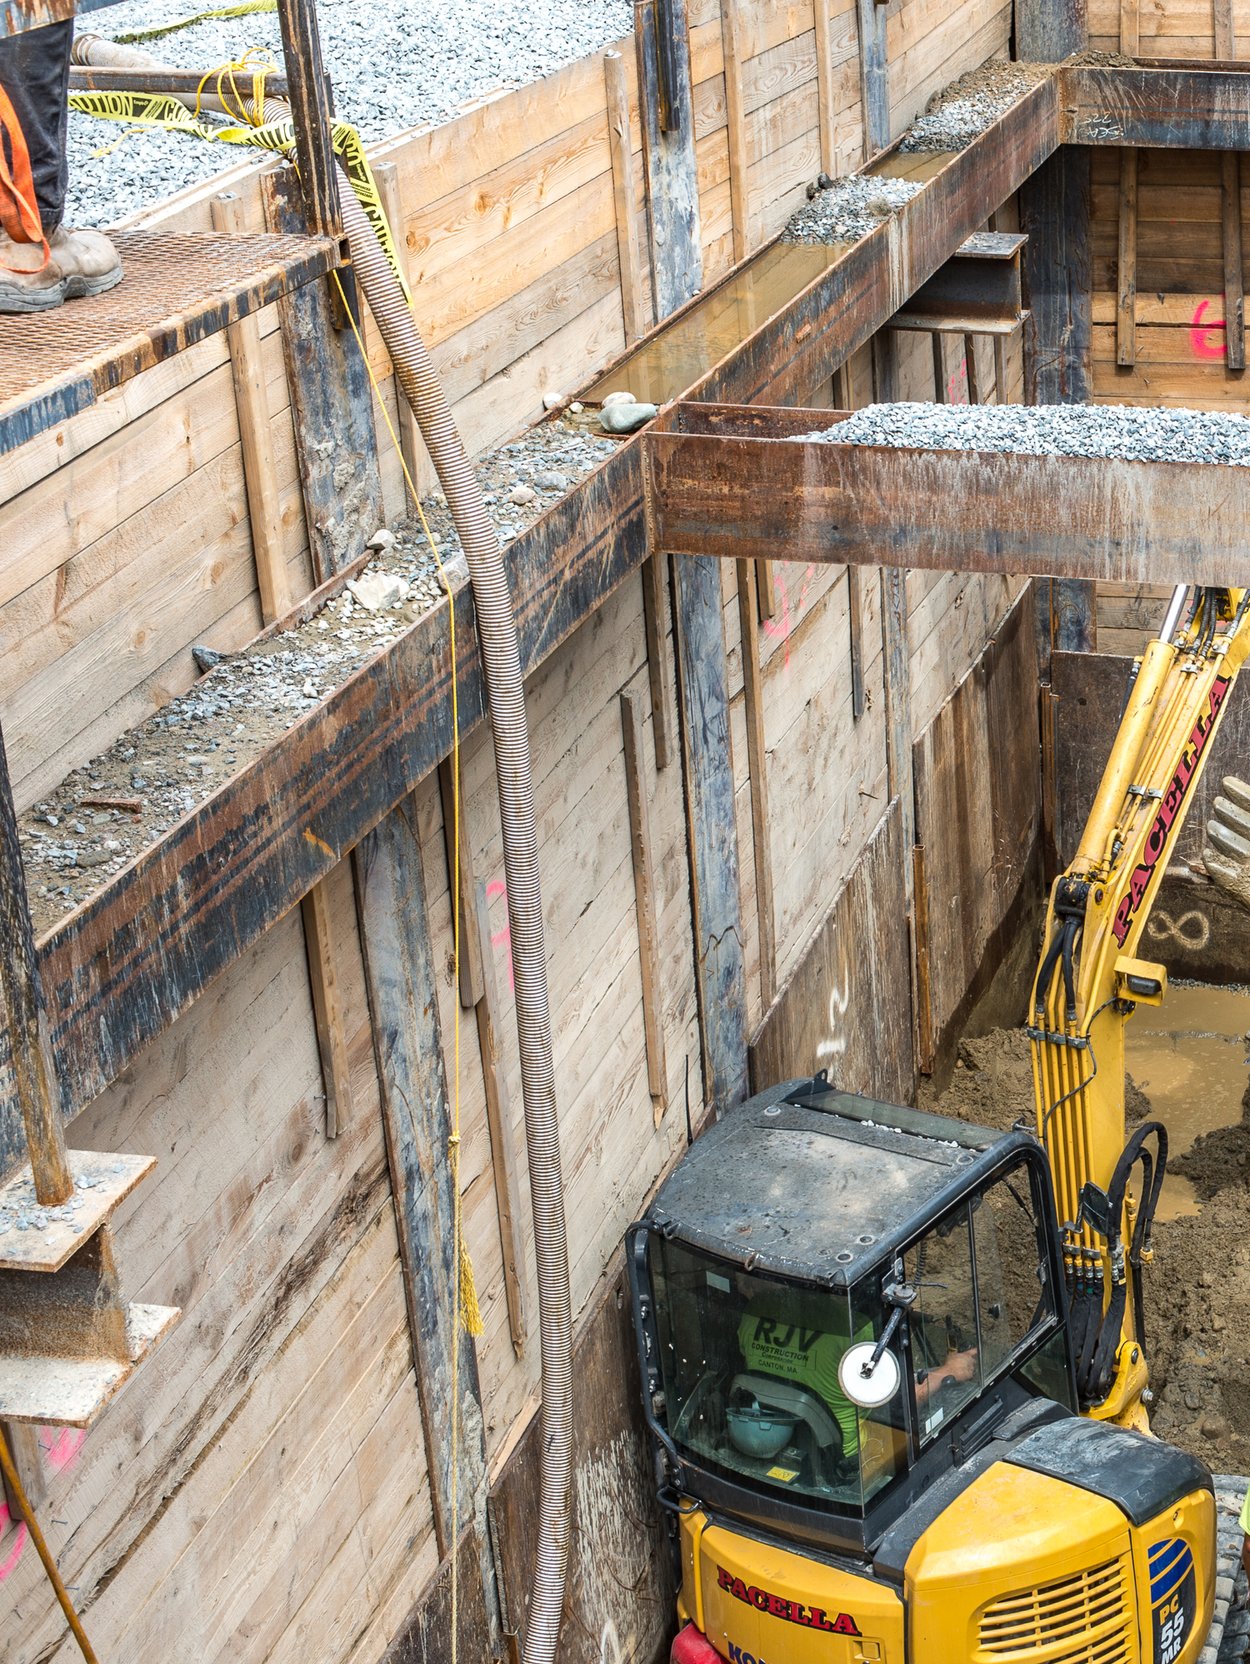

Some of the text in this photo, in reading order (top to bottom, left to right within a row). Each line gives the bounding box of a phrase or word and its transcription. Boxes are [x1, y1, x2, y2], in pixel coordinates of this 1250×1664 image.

[68, 96, 132, 117] AUTION
[1112, 674, 1232, 949] PACELLA
[753, 1316, 824, 1353] RJV
[751, 1342, 809, 1361] CONSTRUCTION
[716, 1565, 863, 1637] PACELLA
[1159, 1594, 1179, 1626] PC
[1160, 1607, 1185, 1650] 55
[727, 1640, 766, 1664] KO
[1161, 1636, 1182, 1664] MR
